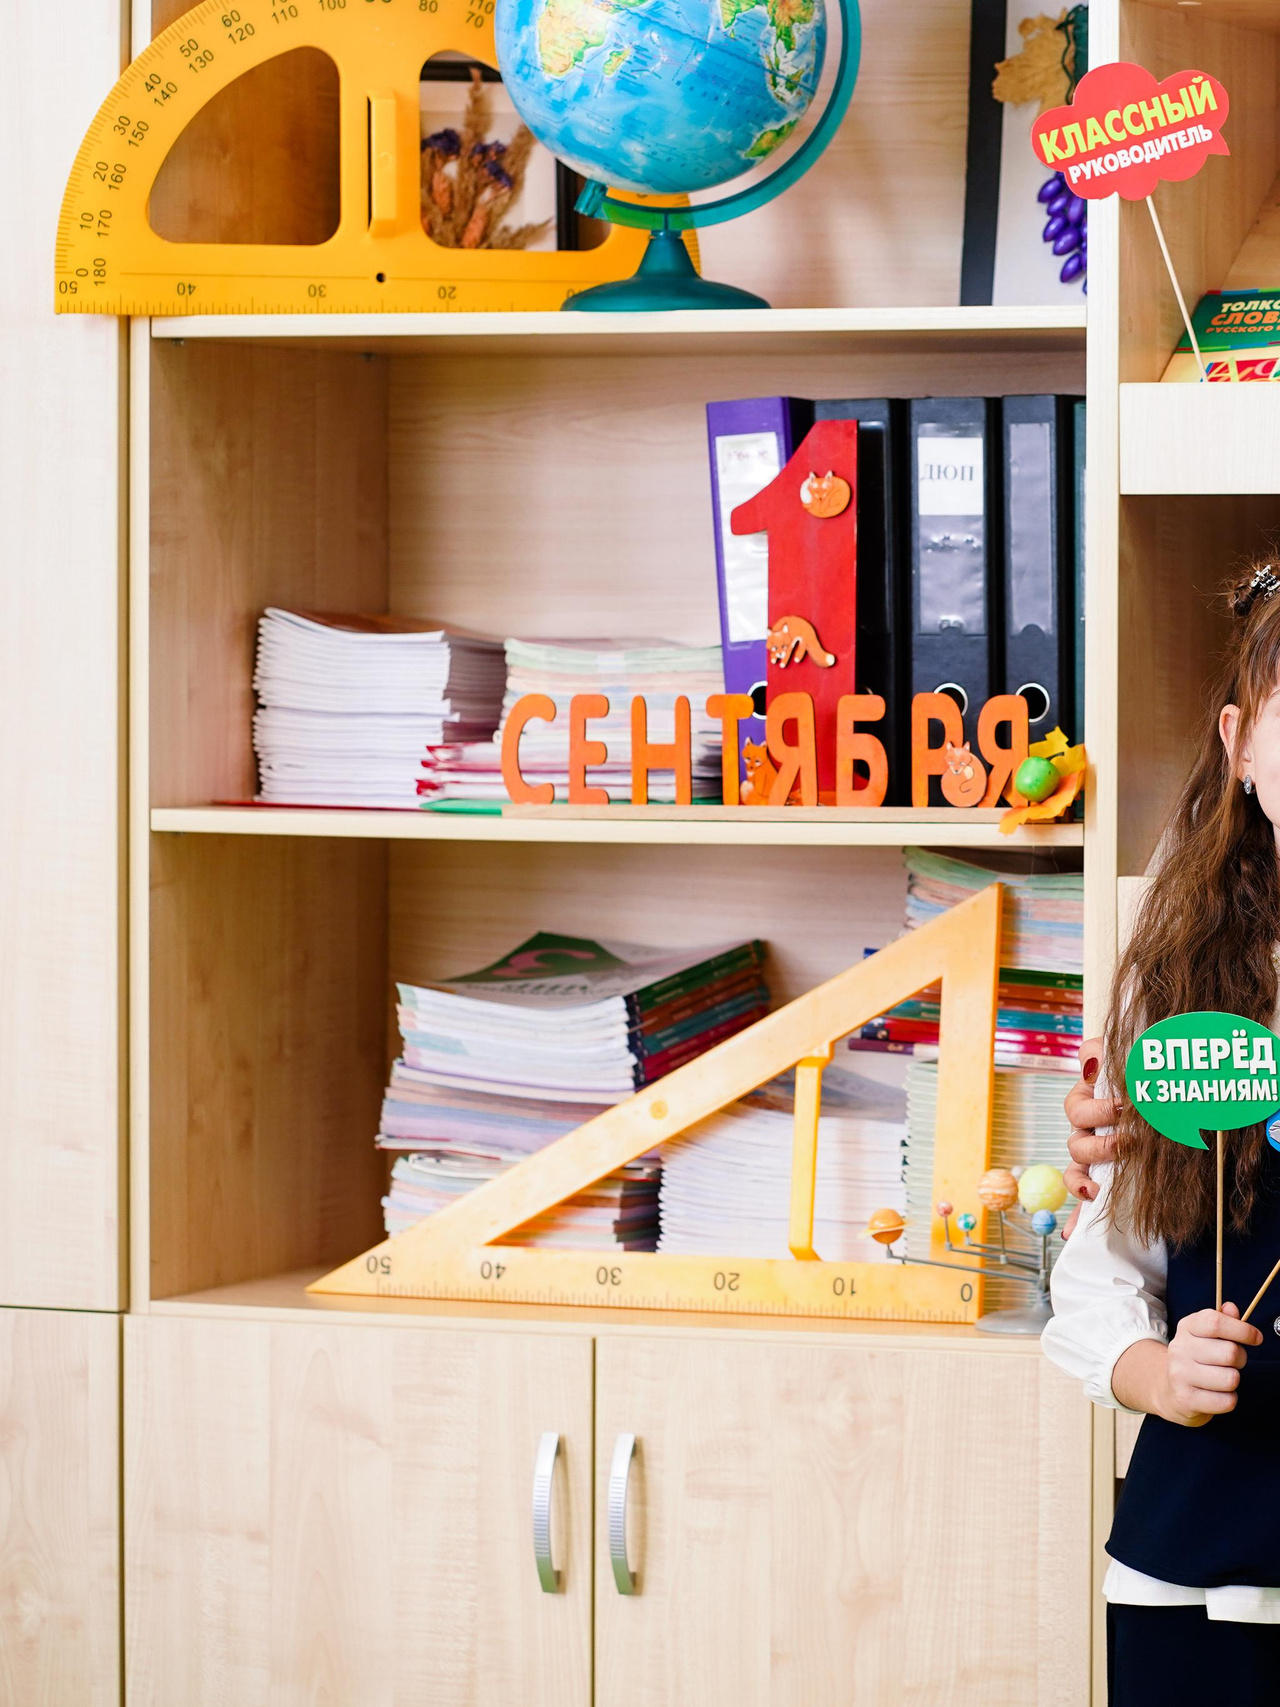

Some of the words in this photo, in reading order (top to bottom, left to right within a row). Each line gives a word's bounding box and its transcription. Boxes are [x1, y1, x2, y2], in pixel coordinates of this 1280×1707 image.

[221, 9, 241, 28] 60
[271, 5, 299, 24] 110
[465, 11, 484, 28] 70
[228, 23, 255, 45] 120
[179, 38, 199, 58] 50
[188, 49, 214, 74] 130
[144, 73, 161, 93] 40
[153, 82, 178, 107] 140
[113, 115, 131, 136] 30
[1038, 76, 1218, 164] КЛАССНЫЙ
[128, 121, 149, 147] 150
[1068, 124, 1213, 184] РУКОВОДИТЕЛЬ
[93, 161, 109, 181] 20
[108, 163, 127, 190] 160
[79, 212, 94, 230] 10
[97, 209, 112, 237] 170
[75, 268, 89, 277] 0
[93, 257, 107, 286] 180
[58, 281, 78, 294] 50
[176, 282, 196, 296] 40
[307, 284, 327, 298] 30
[437, 286, 457, 300] 20
[1205, 325, 1274, 334] РУССКОГО
[919, 463, 974, 482] ДЮП
[501, 692, 1029, 807] СЕНТЯБРЯ
[1142, 1029, 1278, 1075] ВПЕРЁД
[1135, 1080, 1153, 1103] К
[1156, 1079, 1279, 1102] ЗНАНИЯМ!
[366, 1255, 392, 1275] 50
[480, 1260, 507, 1280] 40
[595, 1265, 622, 1287] 30
[713, 1271, 740, 1292] 20
[832, 1276, 858, 1297] 10
[960, 1283, 973, 1303] 0
